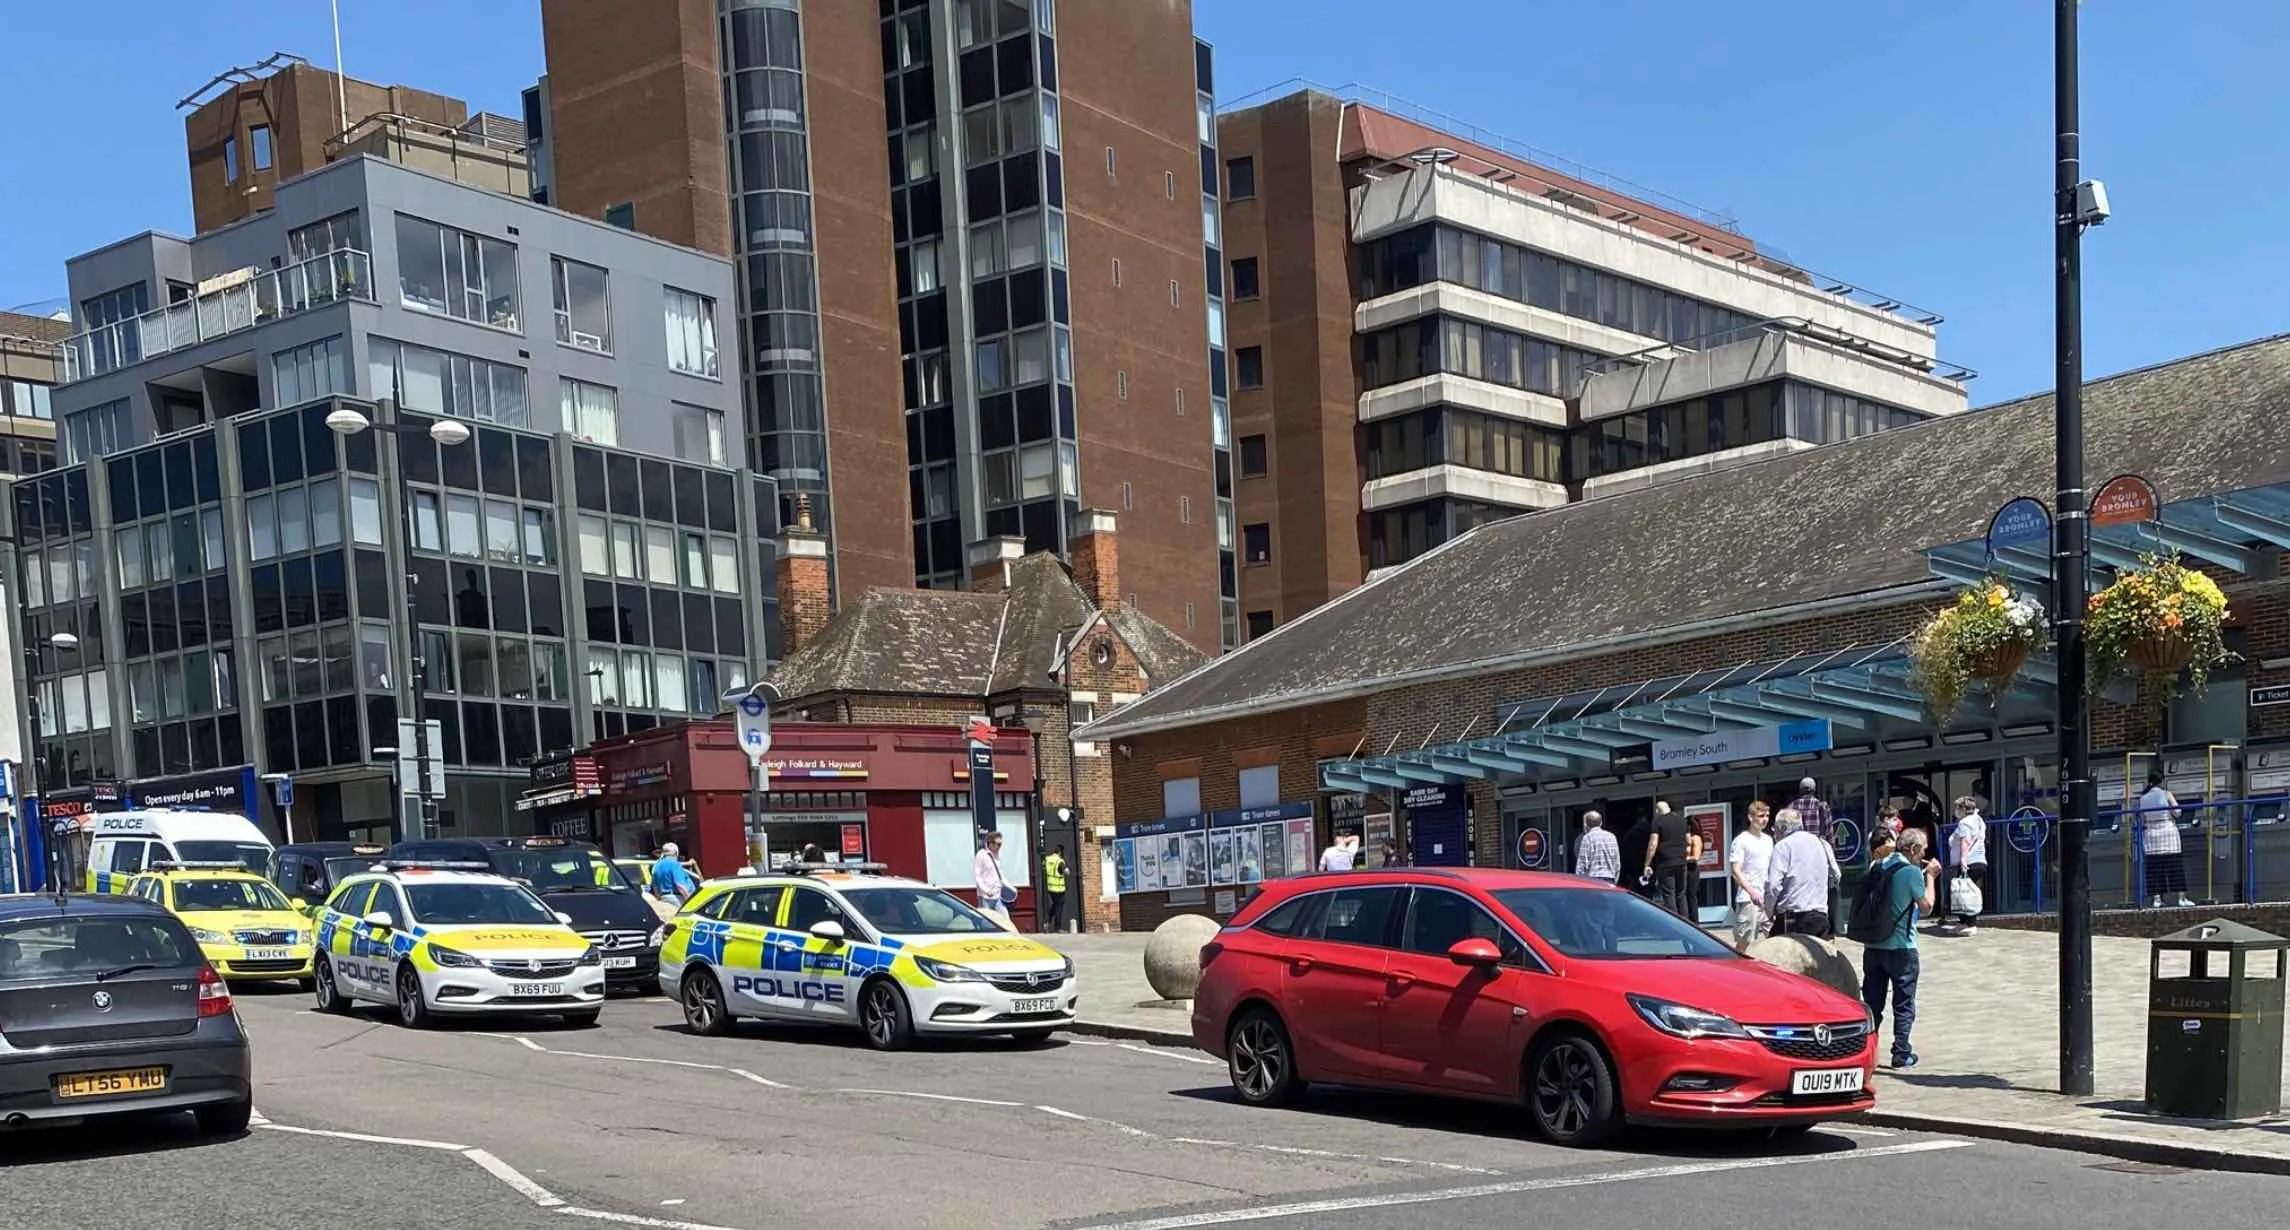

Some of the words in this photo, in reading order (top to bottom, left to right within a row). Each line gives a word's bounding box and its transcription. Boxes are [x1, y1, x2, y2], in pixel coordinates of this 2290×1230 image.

[2112, 491, 2138, 502] YOUR
[2102, 496, 2147, 513] BROMLEY
[2000, 519, 2041, 534] BROMLEY
[2008, 513, 2032, 525] YOUR
[1659, 746, 1698, 761] Bromley
[1699, 741, 1728, 755] South
[789, 760, 817, 769] Folkard
[819, 760, 826, 768] &
[828, 760, 862, 771] Hayward
[144, 795, 162, 806] Open
[163, 793, 181, 804] every
[181, 789, 194, 802] day
[215, 786, 235, 797] 11pm
[48, 801, 81, 816] TESCO
[103, 818, 144, 830] POLICE
[551, 817, 588, 837] COFFEE
[474, 932, 560, 942] POLICE
[962, 943, 1035, 954] POLICE
[337, 960, 391, 985] POLICE
[513, 983, 541, 995] BX69
[542, 983, 561, 994] FUU
[733, 975, 846, 1003] POLICE
[1014, 999, 1038, 1012] BX69
[72, 1074, 122, 1093] LT56
[127, 1070, 162, 1089] YMU
[1801, 1073, 1833, 1091] OU19
[1834, 1071, 1858, 1089] MTK
